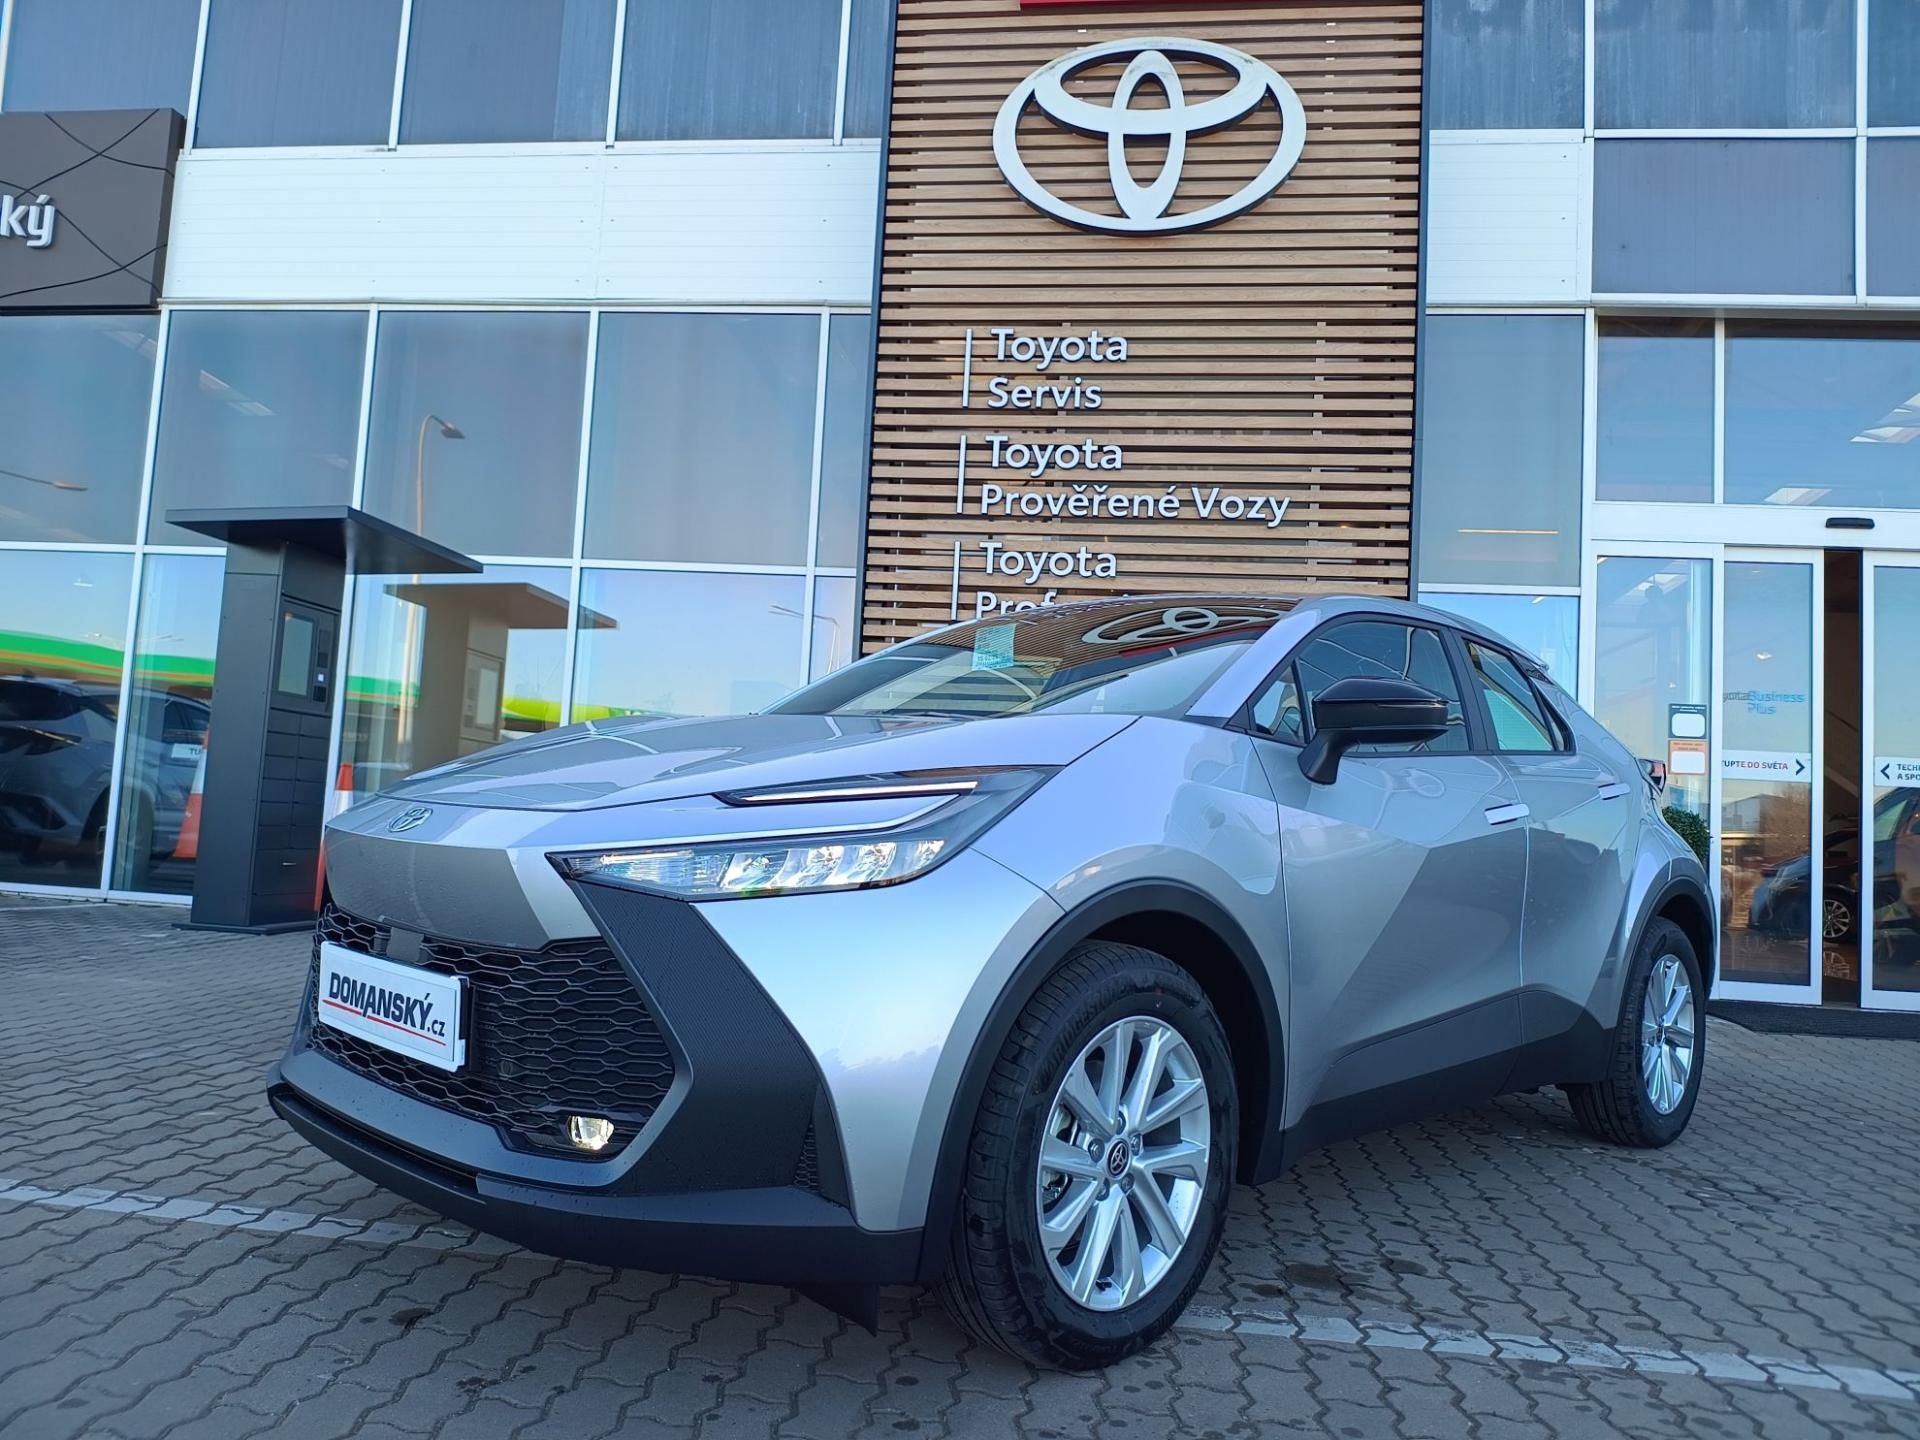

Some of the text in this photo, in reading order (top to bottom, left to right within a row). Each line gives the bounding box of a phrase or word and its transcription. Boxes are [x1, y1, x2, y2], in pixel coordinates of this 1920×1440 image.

[990, 328, 1129, 371] Toyota
[987, 376, 1103, 409] Servis
[984, 434, 1123, 477] Toyota
[980, 483, 1292, 528] Prověřené Vozy
[979, 541, 1118, 585] Toyota
[1747, 702, 1777, 715] Plus
[1747, 761, 1760, 769] DO
[1896, 763, 1920, 771] TECH
